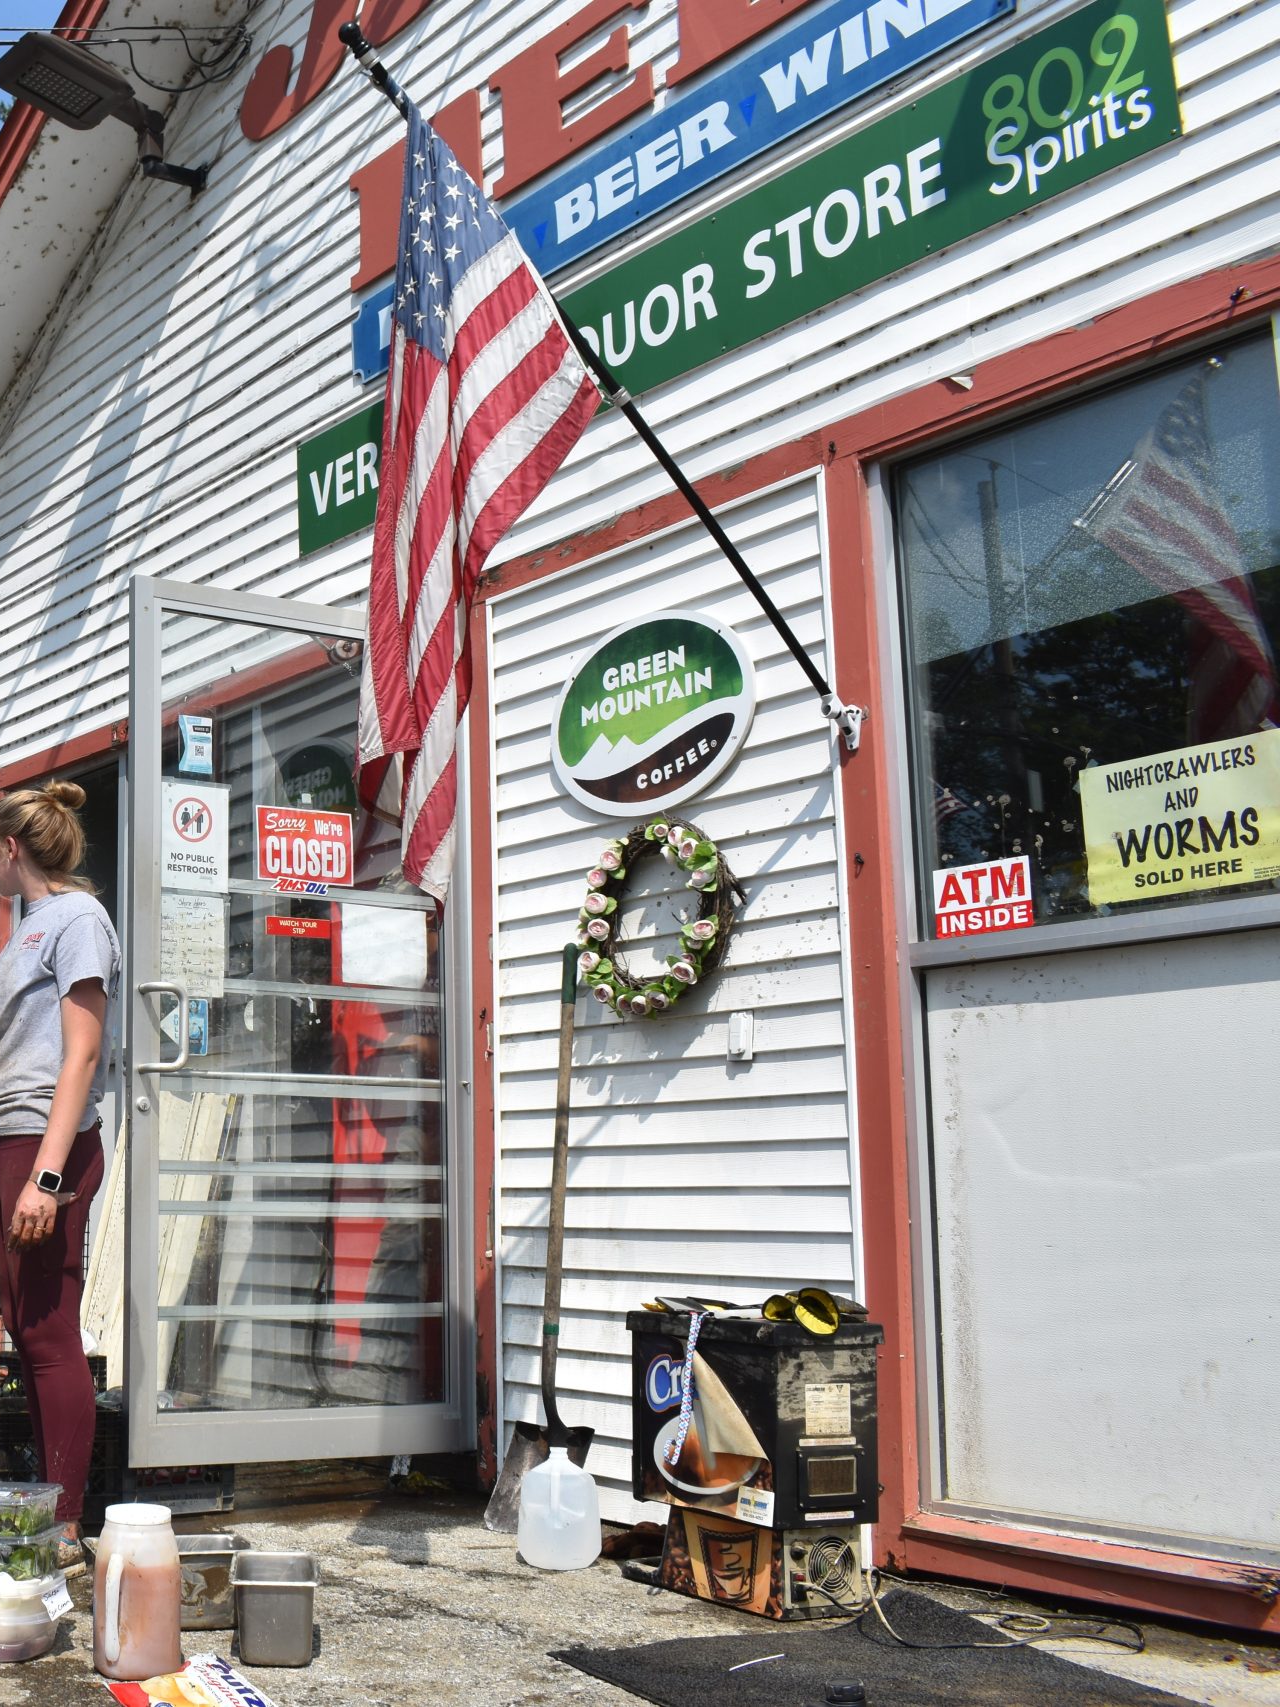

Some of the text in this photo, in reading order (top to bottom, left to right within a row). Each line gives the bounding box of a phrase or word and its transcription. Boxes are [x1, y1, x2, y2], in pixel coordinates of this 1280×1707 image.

[981, 14, 1145, 153] 802
[986, 88, 1153, 196] Spirits
[554, 100, 737, 245] BEER
[309, 442, 380, 517] VER
[743, 136, 946, 299] STORE
[602, 645, 686, 692] GREEN
[580, 666, 713, 727] MOUNTAIN
[636, 738, 711, 790] COFFEE
[1105, 744, 1256, 794] NIGHTCRAWLERS
[1164, 786, 1199, 813] AND
[264, 812, 343, 837] Sorry We're
[1115, 806, 1260, 868] WORMS
[167, 863, 219, 876] RESTROOMS
[170, 852, 215, 864] NO PUBLIC
[265, 835, 347, 879] CLOSED
[1134, 868, 1184, 888] SOLD
[1191, 858, 1244, 881] HERE
[273, 877, 328, 895] AMSOIL
[939, 863, 1026, 909] ATM
[279, 920, 317, 930] WATCH YOUR
[292, 927, 306, 935] STEP
[941, 905, 1029, 934] INSIDE
